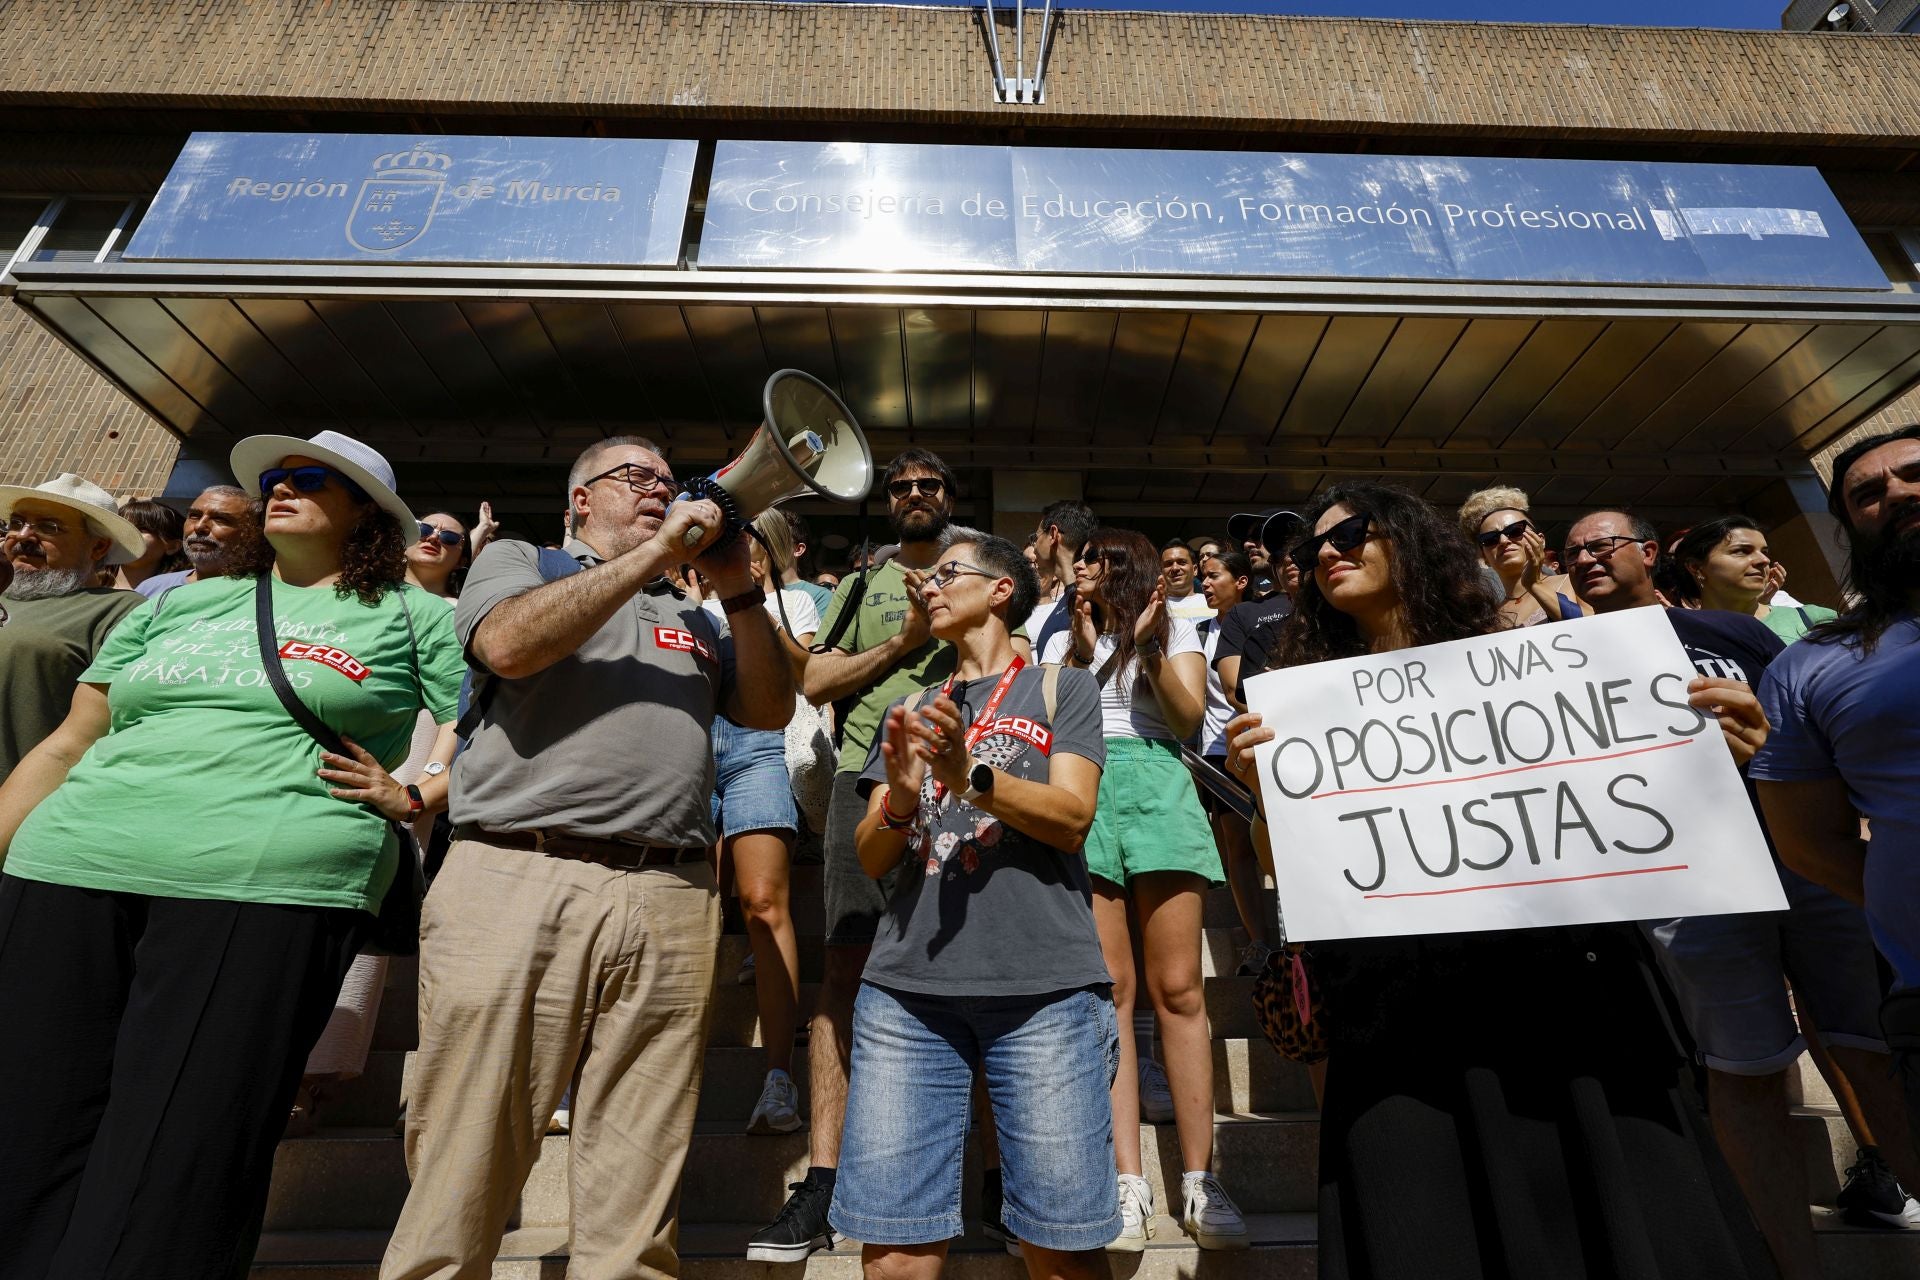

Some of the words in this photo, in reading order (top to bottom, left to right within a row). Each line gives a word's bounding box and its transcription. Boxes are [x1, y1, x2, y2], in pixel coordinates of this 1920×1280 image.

[227, 176, 348, 201] Región
[452, 178, 496, 200] de
[506, 180, 621, 202] Murcia
[746, 188, 945, 220] Consejería
[961, 192, 1005, 217] de
[1022, 194, 1224, 224] Educación,
[1239, 197, 1433, 227] Formación
[1443, 203, 1647, 231] Profesional
[284, 642, 366, 677] CCOO
[1352, 660, 1436, 706] POR
[1466, 634, 1588, 687] UNAS
[1271, 673, 1707, 799] OPOSICIONES
[1338, 774, 1675, 891] JUSTAS
